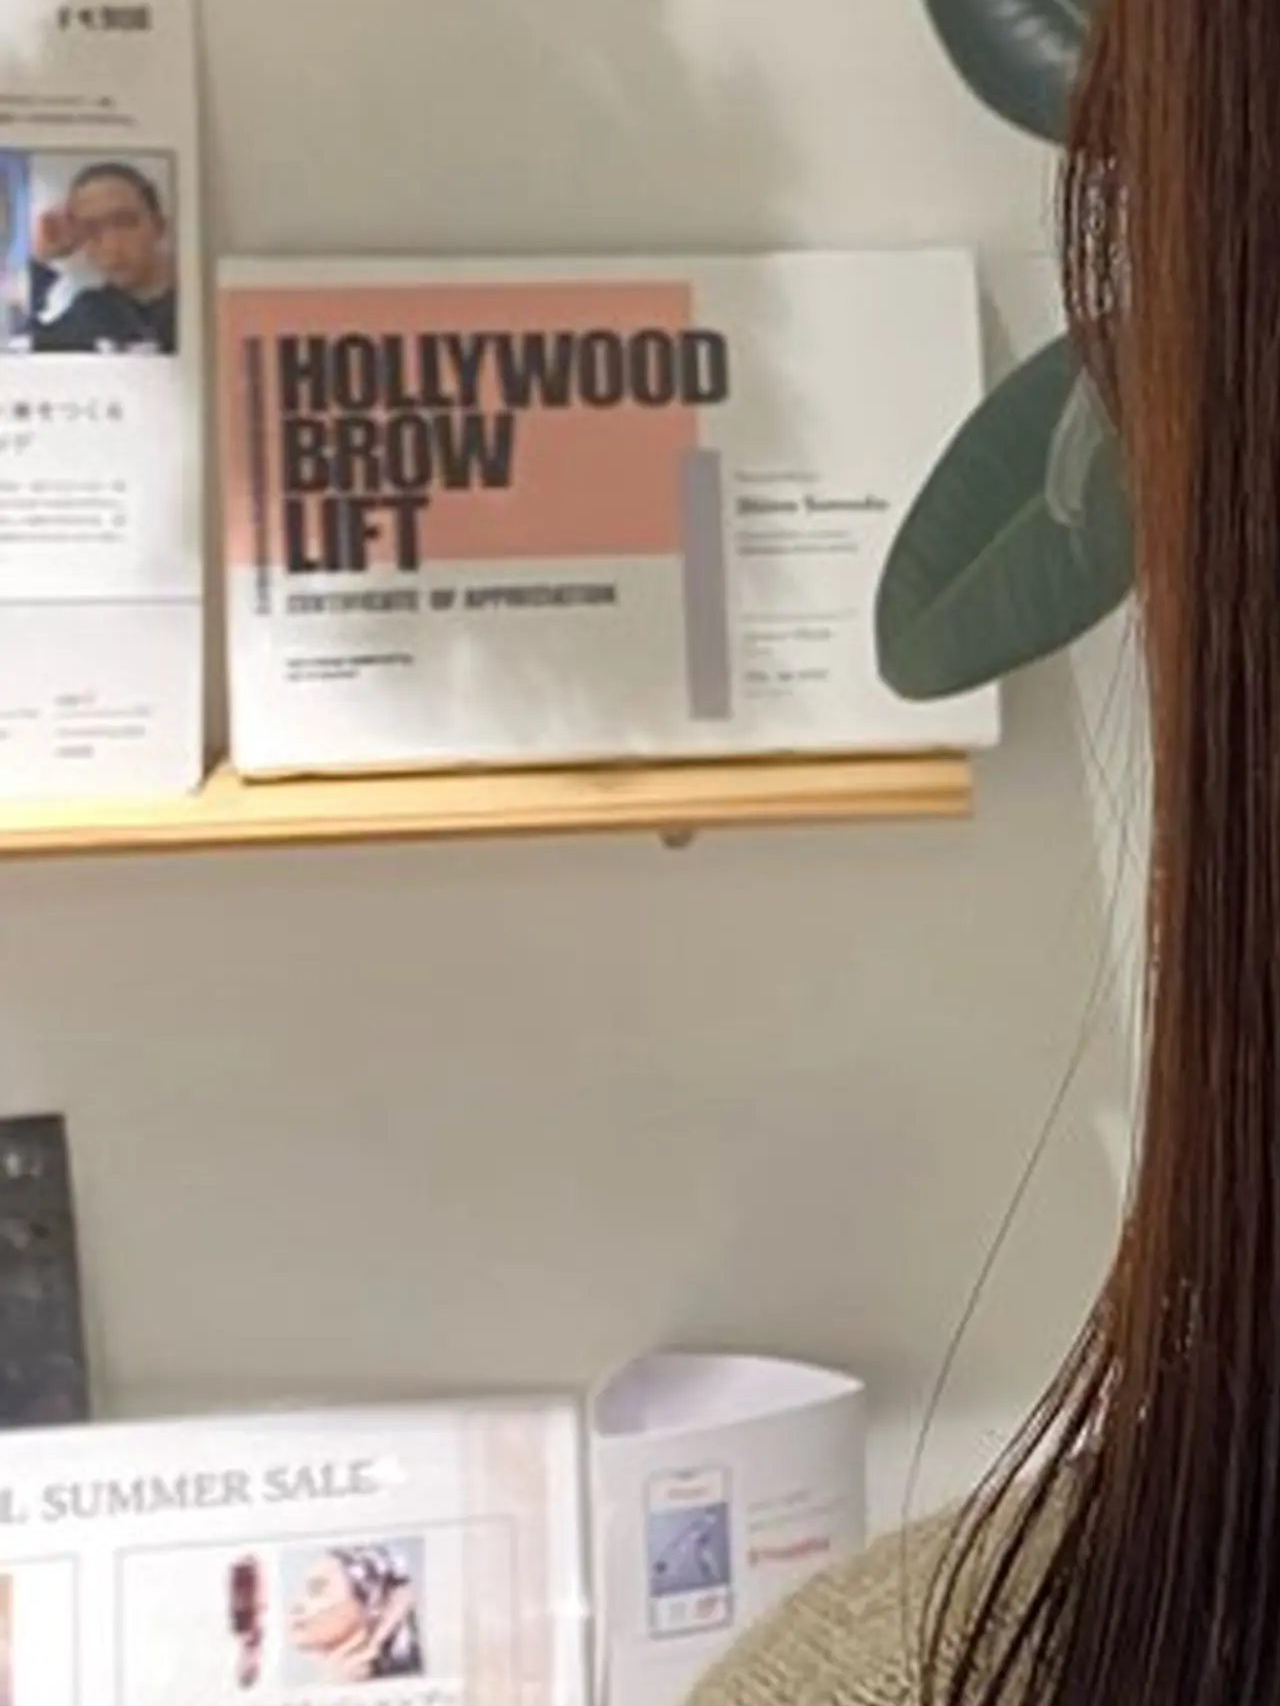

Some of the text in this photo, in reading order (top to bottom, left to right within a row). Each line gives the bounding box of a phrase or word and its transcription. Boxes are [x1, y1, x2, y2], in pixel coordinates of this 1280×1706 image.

[278, 329, 729, 411] HOLLYWOOD
[284, 412, 516, 494] BROW
[286, 494, 430, 575] LIFT
[41, 1469, 251, 1524] SUMMER
[262, 1458, 382, 1504] SALE
